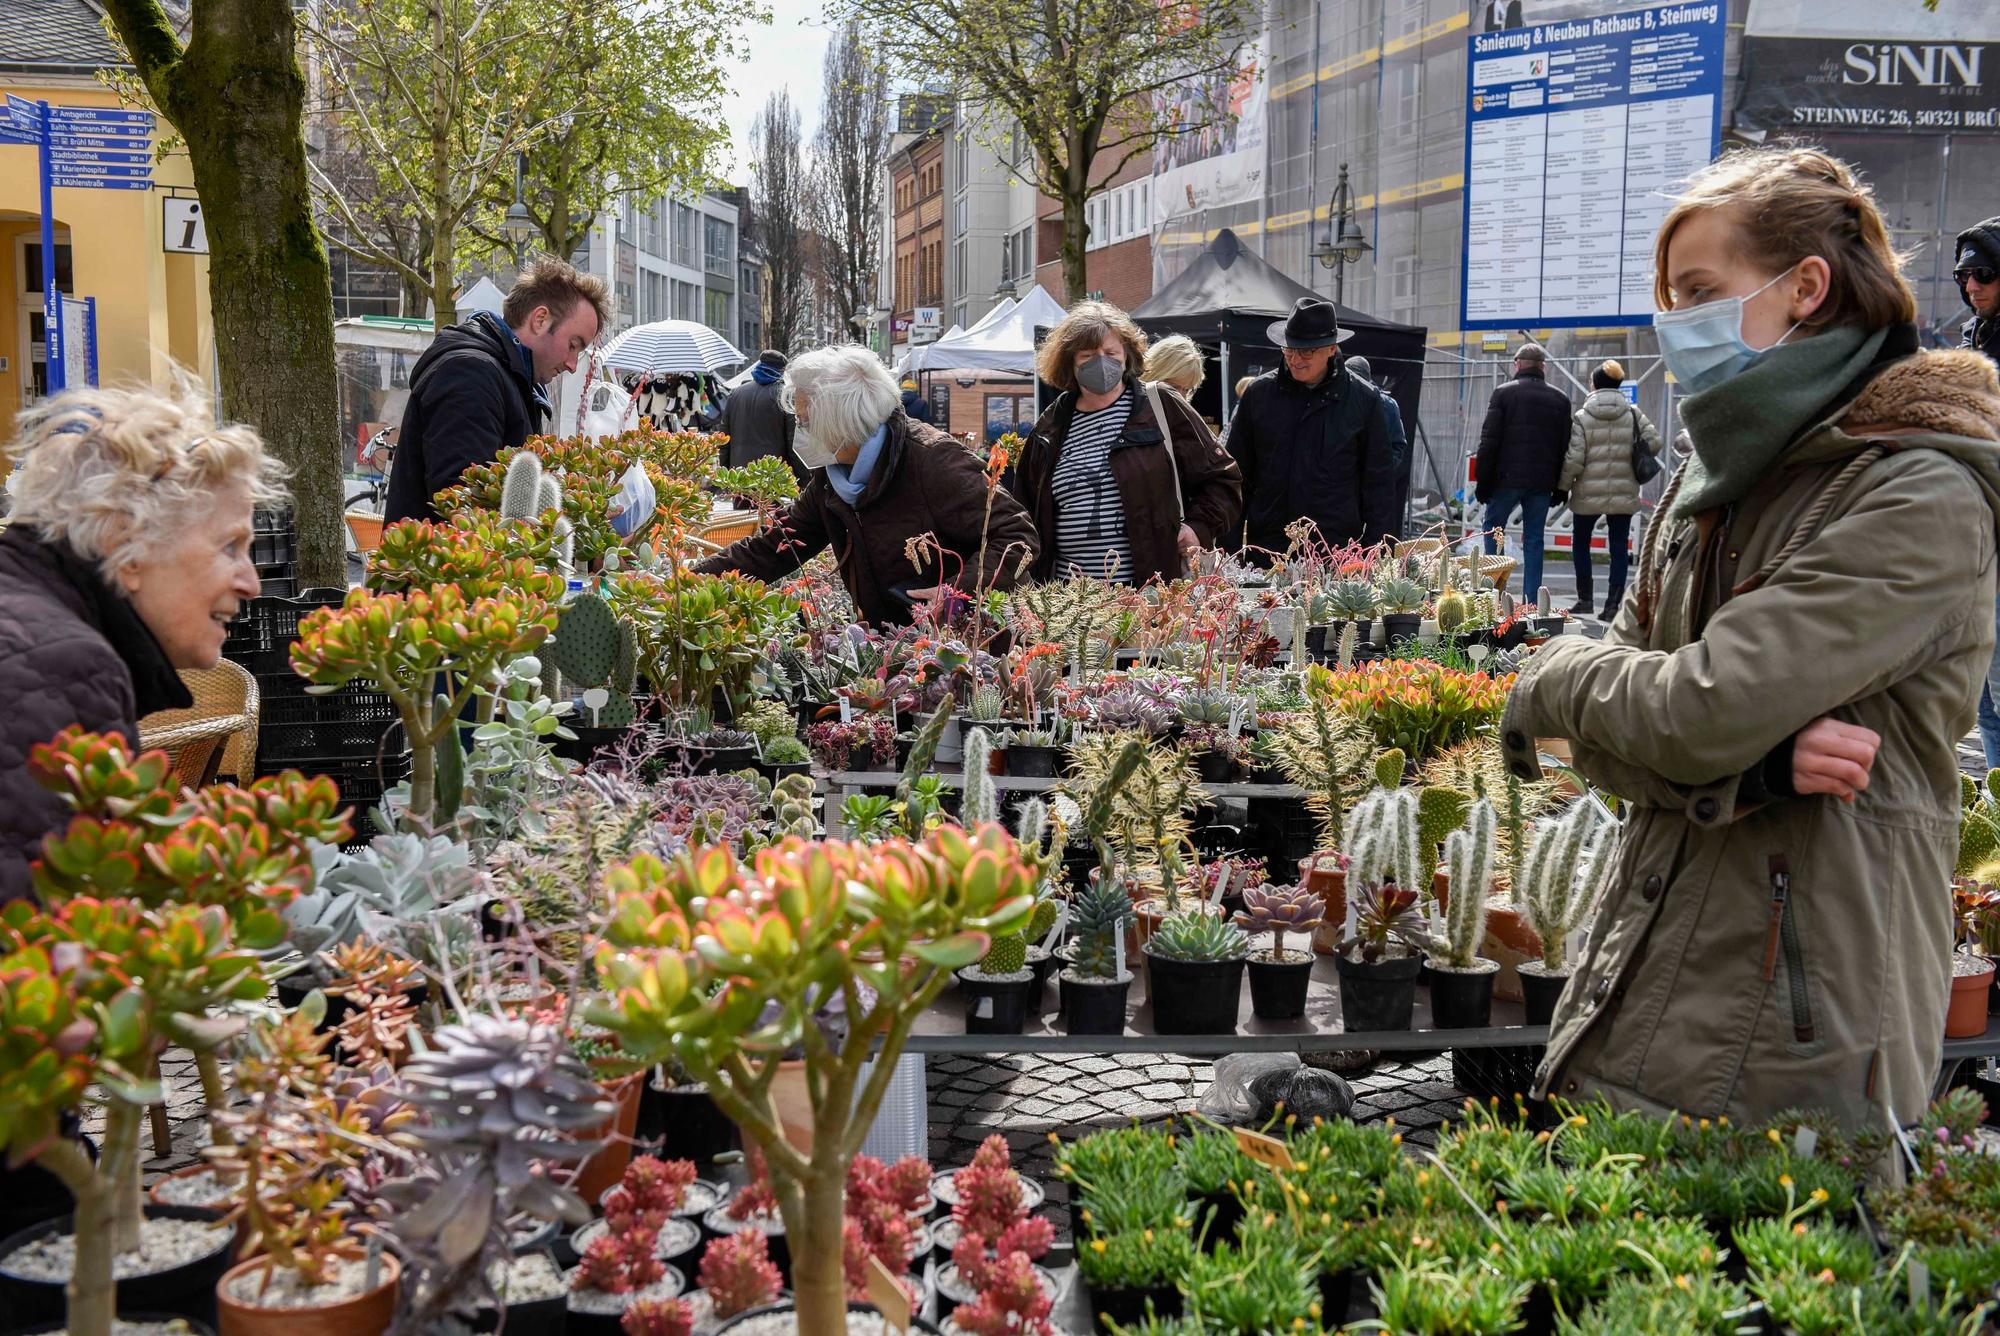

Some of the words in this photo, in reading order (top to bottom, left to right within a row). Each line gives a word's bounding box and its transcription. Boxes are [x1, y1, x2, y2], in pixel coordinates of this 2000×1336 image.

[1475, 33, 1531, 53] Sanierung
[1533, 27, 1543, 44] &
[1545, 22, 1590, 43] Neubau
[1593, 15, 1641, 36] Rathaus
[1644, 11, 1656, 30] B,
[1659, 4, 1718, 26] Steinweg
[1843, 43, 1985, 87] SiNN
[60, 111, 97, 120] Amtsgericht
[1793, 107, 1886, 125] STEINWEG
[1889, 109, 1912, 128] 26,
[1915, 110, 1959, 127] 50321
[70, 138, 87, 146] Brühl
[88, 139, 105, 147] Mitte
[51, 151, 99, 160] Stadtbibliothek
[61, 165, 108, 174] Marienhospital
[62, 178, 105, 188] Mühlenstraße
